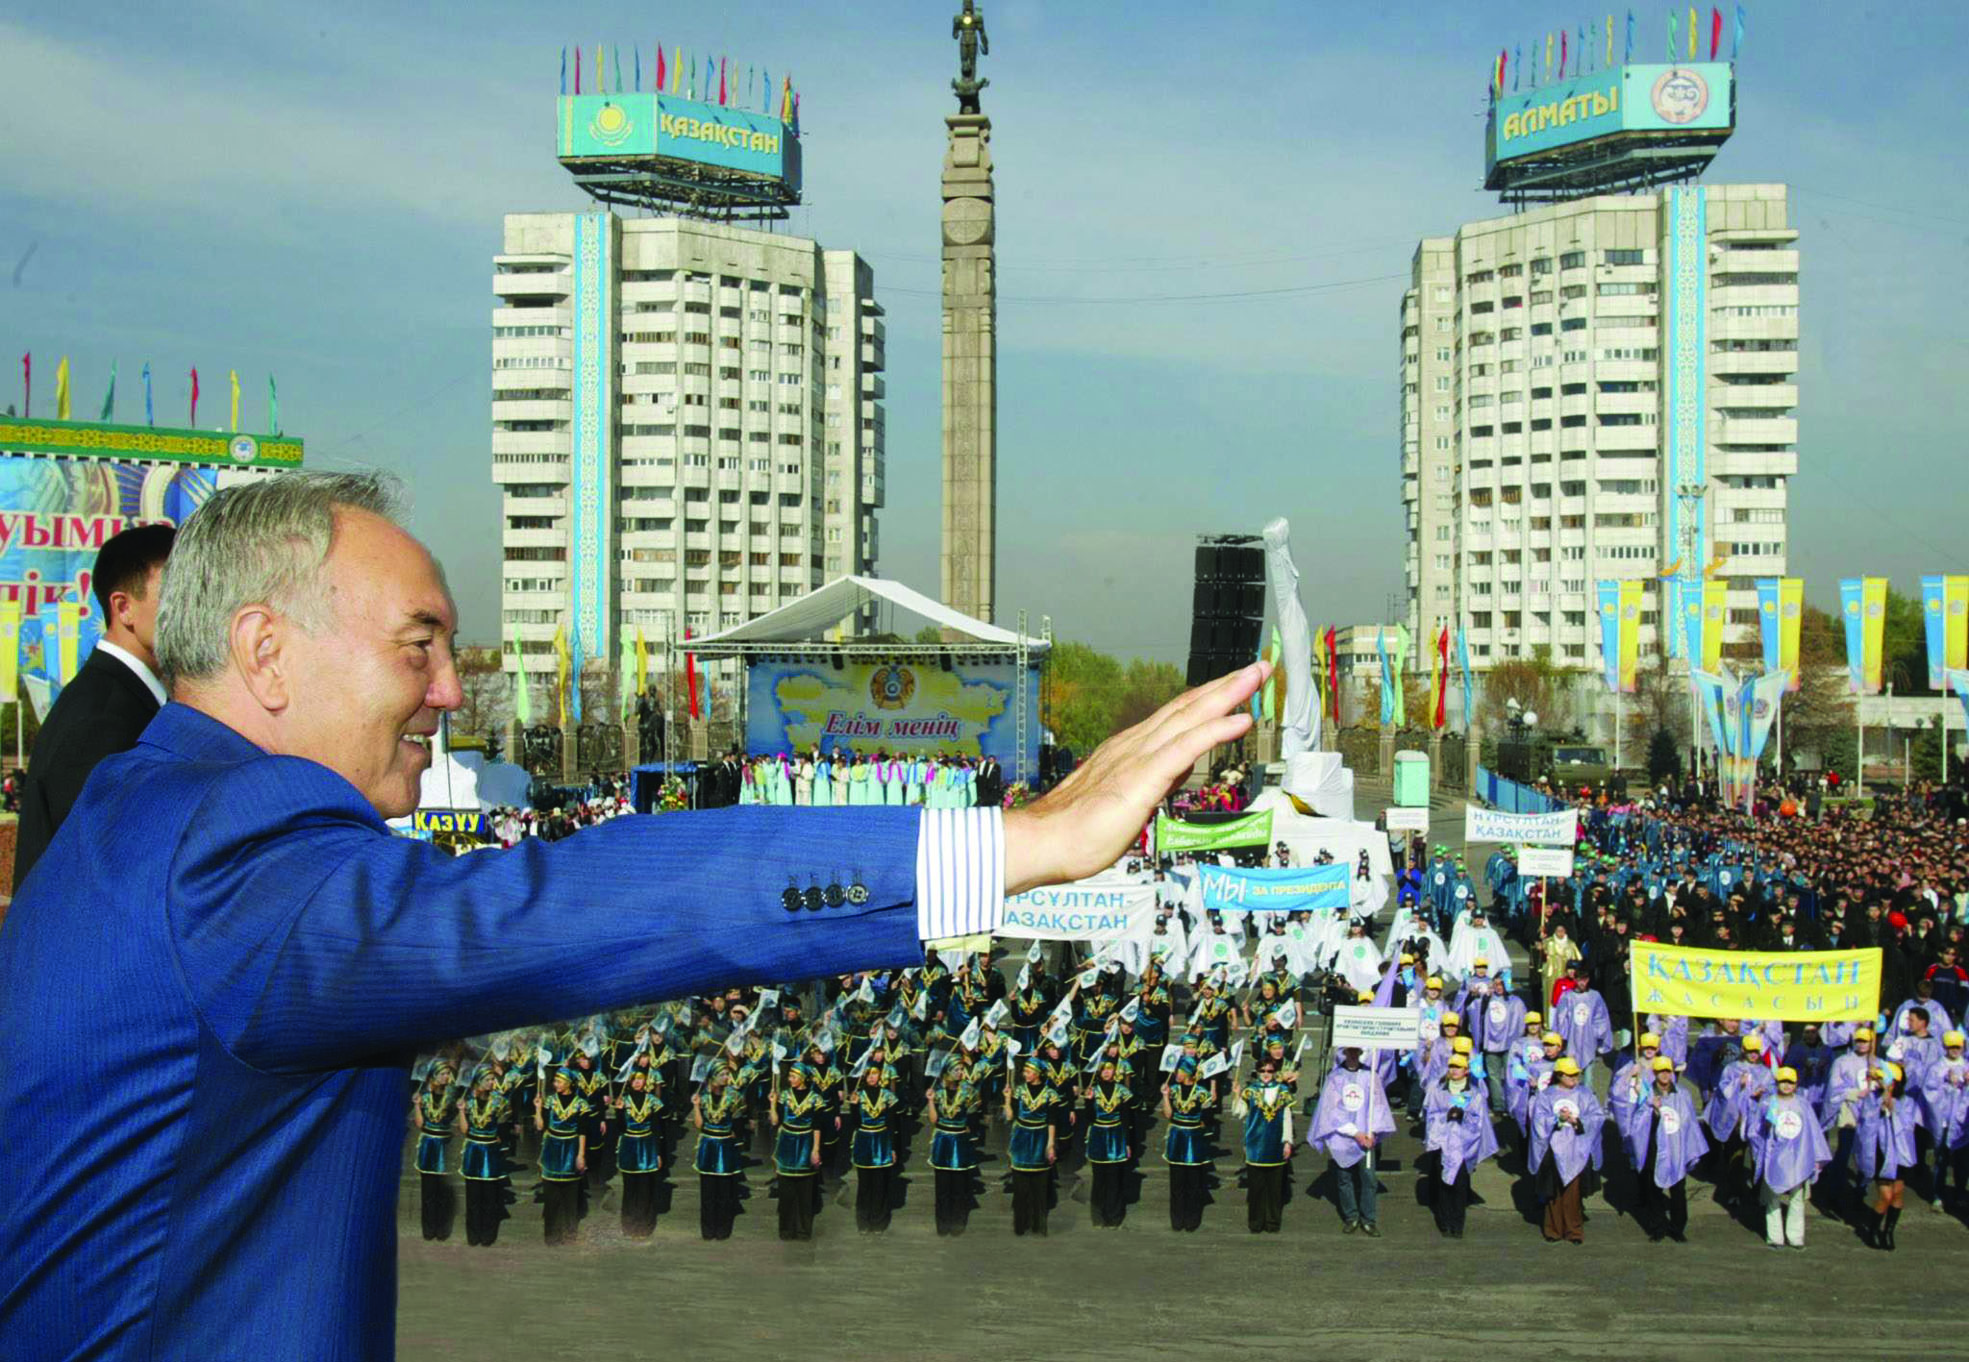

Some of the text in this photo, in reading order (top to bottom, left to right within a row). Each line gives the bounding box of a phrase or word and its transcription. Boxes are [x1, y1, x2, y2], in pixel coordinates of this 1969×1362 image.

[1503, 85, 1619, 141] АЛМАТЫ
[660, 113, 779, 155] ҚАЗАҚСТАН
[825, 711, 959, 739] Елім менің
[1475, 823, 1561, 840] ҚАЗАҚСТАН
[1203, 872, 1247, 904] МЫ
[1006, 911, 1128, 932] АЗАҚСТАН
[1647, 951, 1862, 990] ҚАЗАҚСТАН
